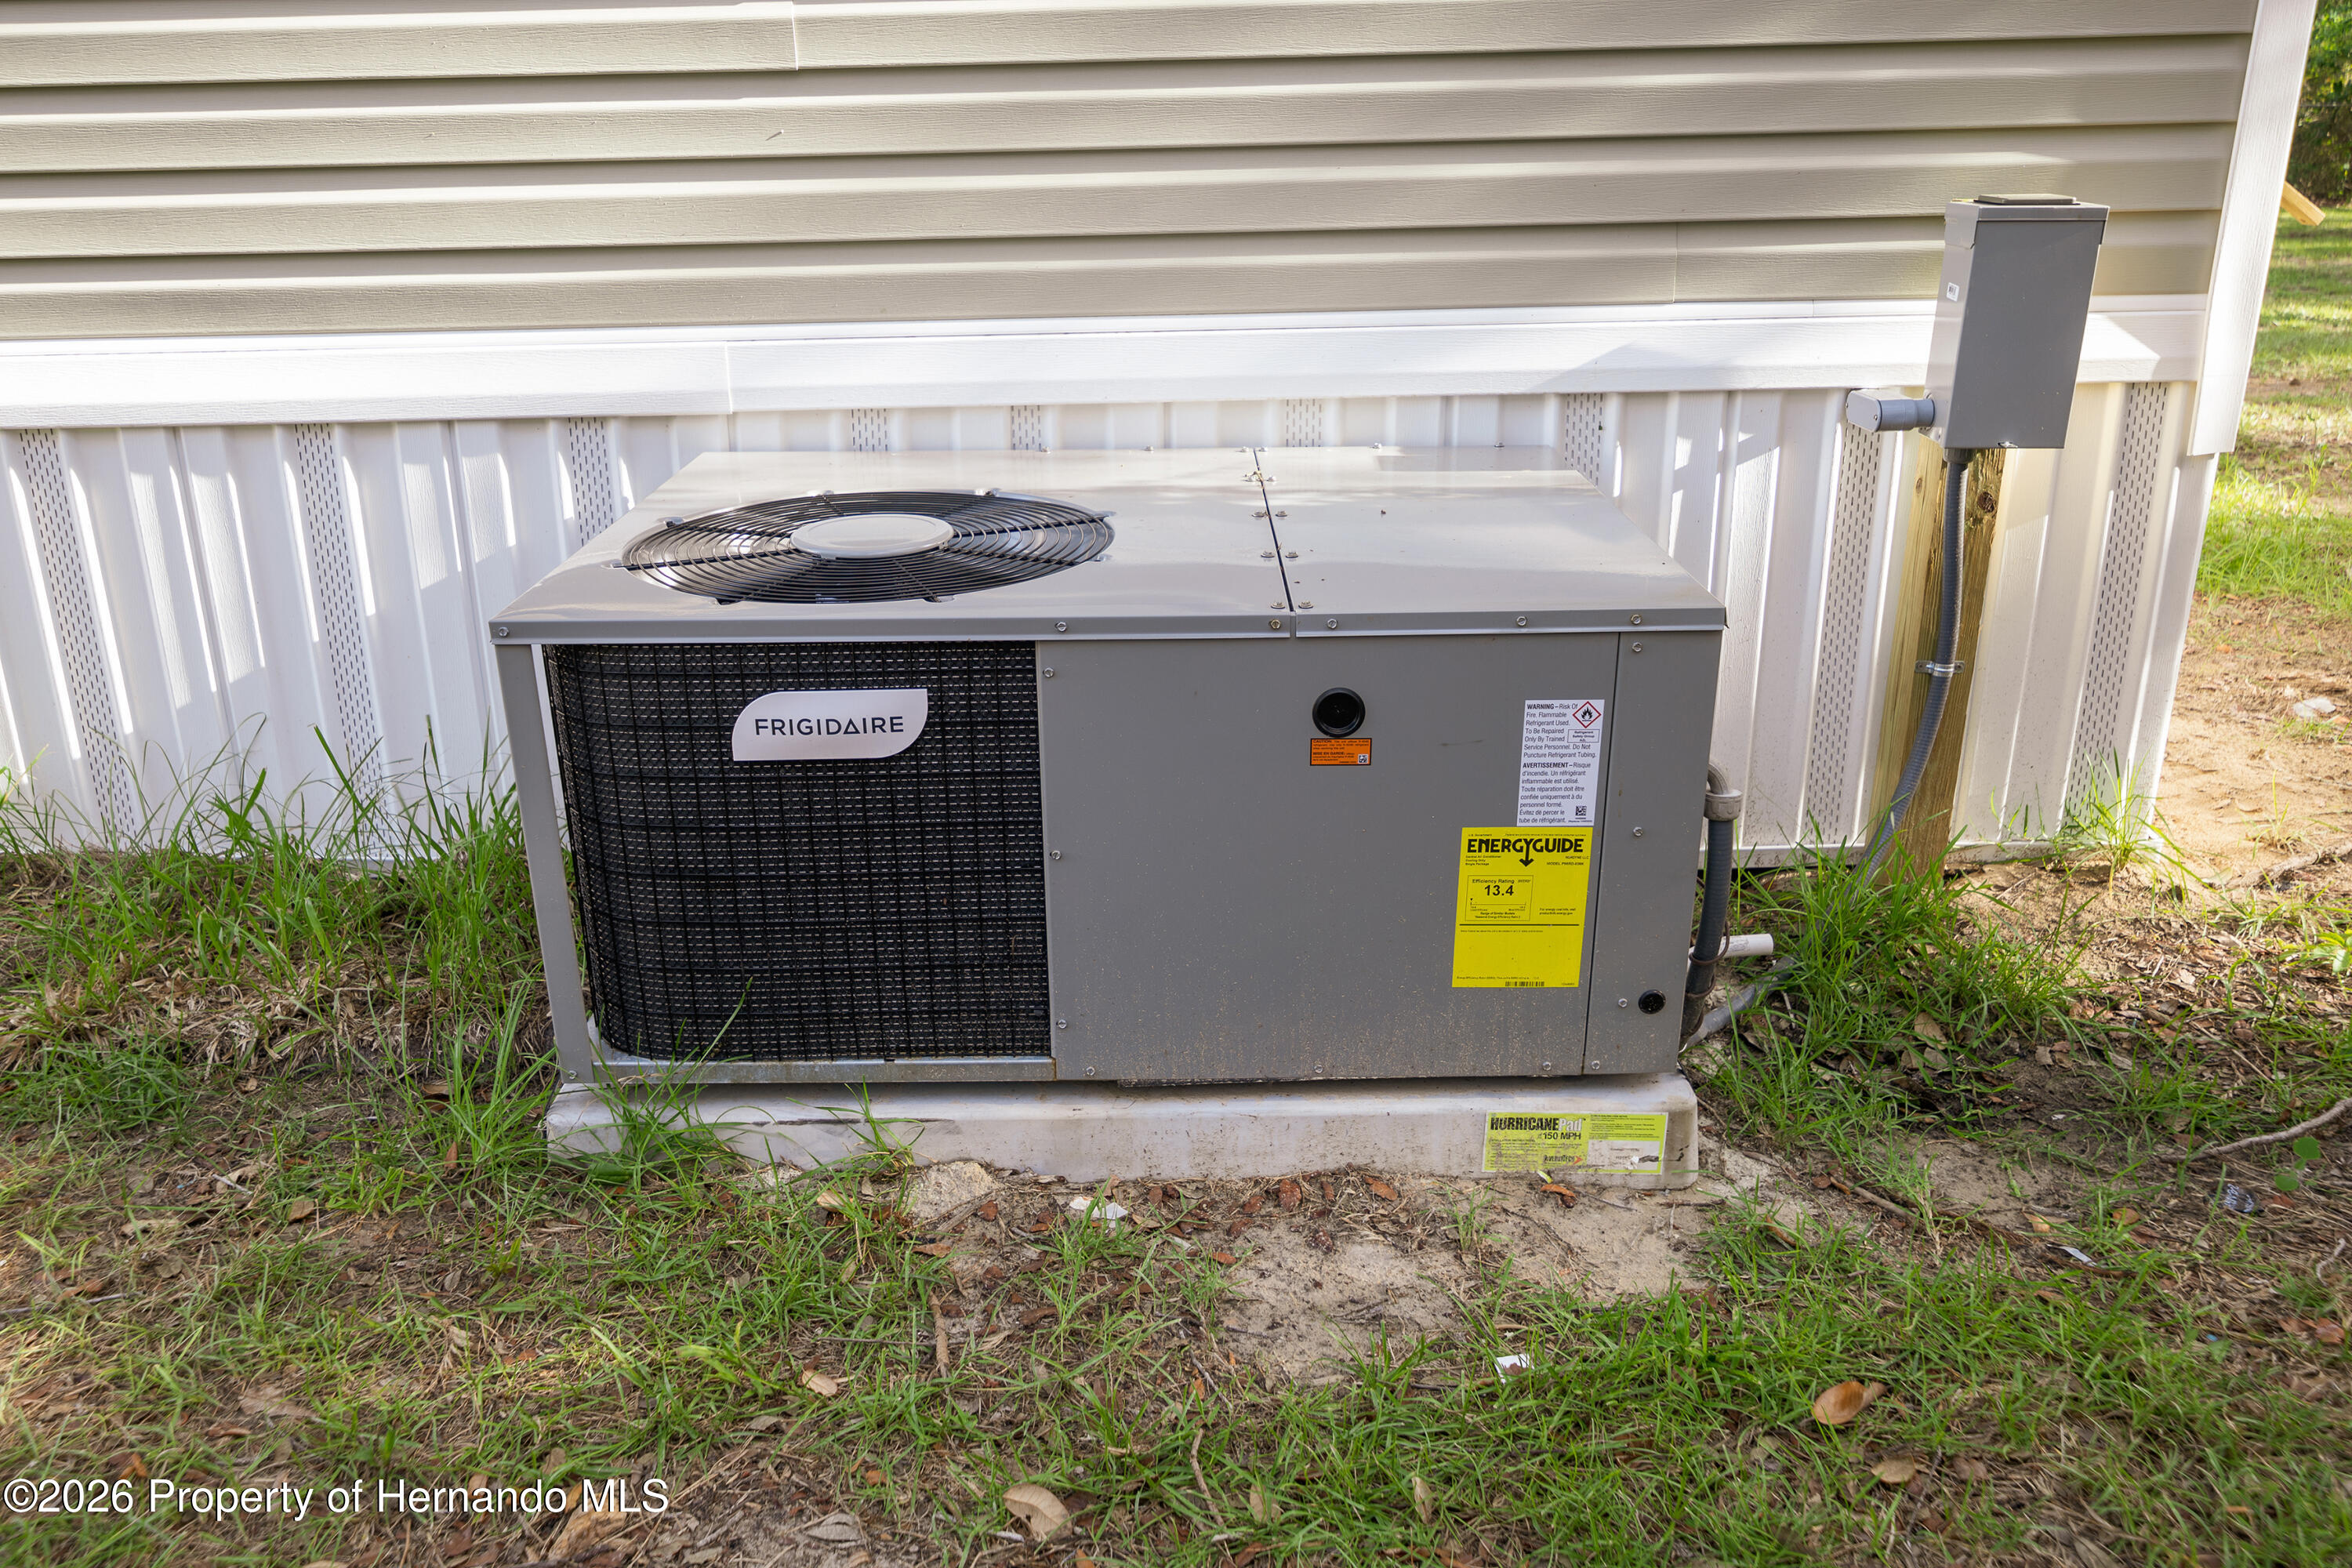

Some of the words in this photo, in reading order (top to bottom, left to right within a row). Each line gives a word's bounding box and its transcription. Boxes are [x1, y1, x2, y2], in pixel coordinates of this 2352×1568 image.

[754, 716, 904, 735] FRIGIDAIRE
[1467, 838, 1584, 853] ENERGYGUIDE
[1484, 884, 1514, 896] 13.4
